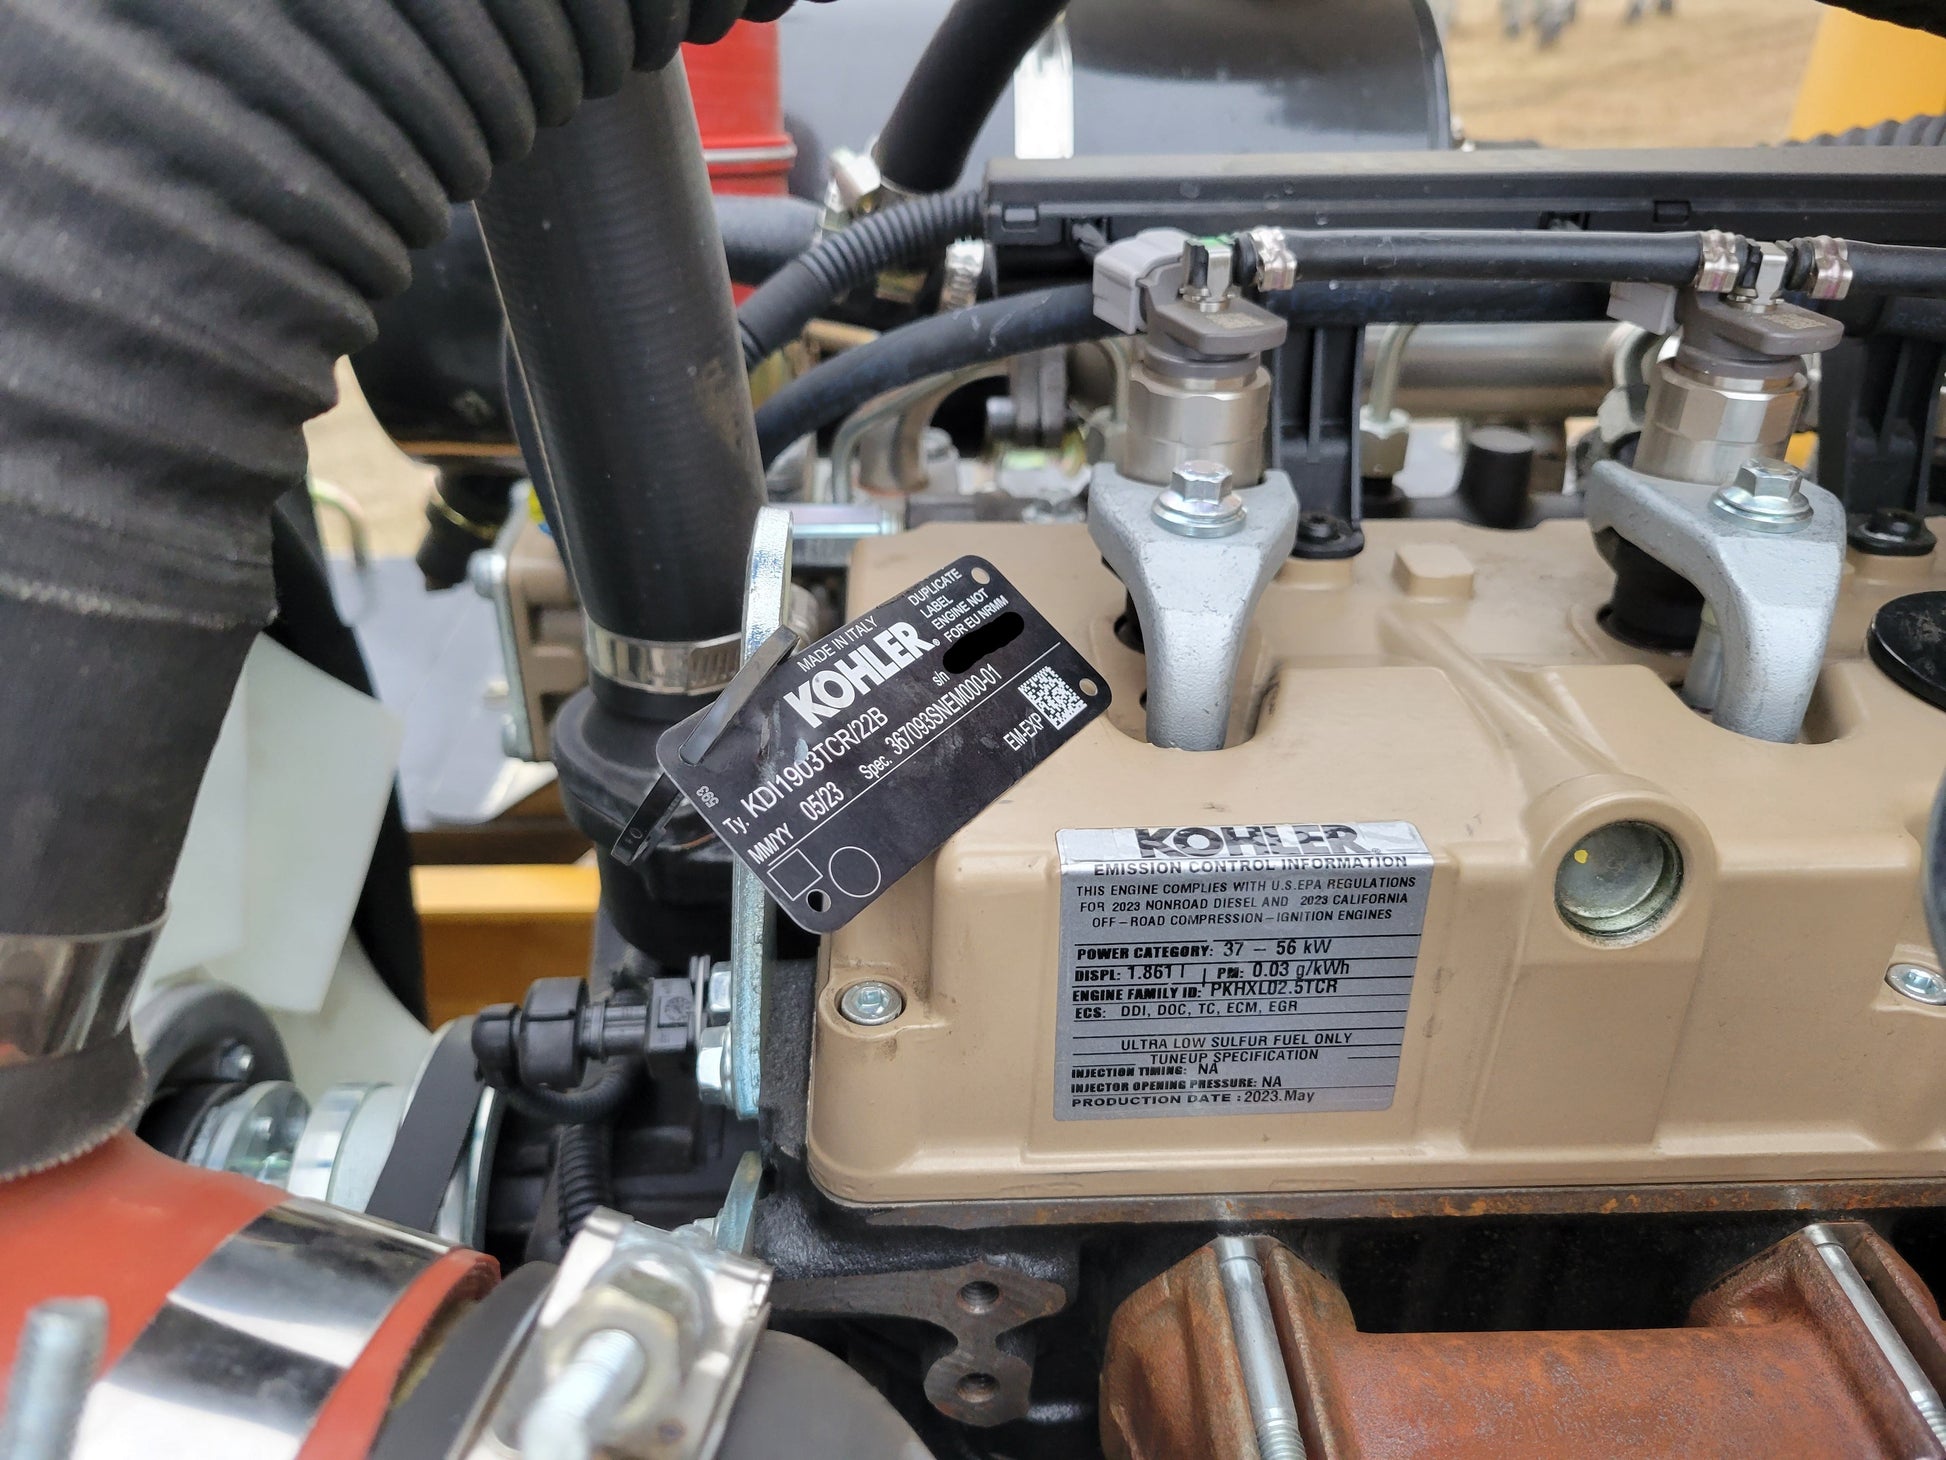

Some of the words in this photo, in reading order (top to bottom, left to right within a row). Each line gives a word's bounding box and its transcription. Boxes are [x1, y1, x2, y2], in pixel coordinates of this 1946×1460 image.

[908, 568, 962, 607] DUPLICATE
[920, 595, 954, 619] LABEL
[931, 604, 970, 631] ENGINE
[967, 588, 989, 611] NOT
[944, 625, 966, 642] FOR
[966, 614, 980, 629] EU
[976, 595, 1009, 621] NRMM
[797, 644, 835, 672] MADE
[834, 634, 849, 650] IN
[845, 616, 878, 642] ITALY
[783, 621, 934, 729] KOHLER
[932, 670, 950, 687] s/n
[1003, 712, 1045, 752] EM-EXP
[722, 816, 750, 834] Ty.
[740, 706, 889, 819] KDI1903TCR/22B
[747, 822, 794, 865] MM/YY
[799, 781, 845, 821] 05/23
[858, 755, 893, 780] Spec.
[884, 663, 1003, 755] 367093SNEM000-01
[696, 785, 720, 809] 593
[1134, 824, 1371, 858] KOHLER
[1094, 861, 1182, 876] EMISSION
[1189, 859, 1275, 873] CONTROL
[1282, 856, 1407, 871] INFORMATION
[1077, 886, 1105, 896] THIS
[1111, 884, 1158, 895] ENGINE
[1163, 882, 1227, 894] COMPLIES
[1233, 881, 1266, 892] WITH
[1271, 879, 1322, 891] U.S.EPA
[1327, 877, 1416, 889] REGULATIONS
[1080, 902, 1105, 912] FOR
[1112, 901, 1141, 912] 2023
[1146, 899, 1208, 910] NONROAD
[1213, 897, 1257, 909] DIESEL
[1262, 896, 1289, 907] AND
[1300, 895, 1328, 906] 2023
[1332, 893, 1408, 905] CALIFORNIA
[1338, 909, 1392, 920] ENGINES
[1077, 947, 1129, 960] POWER
[1134, 945, 1213, 959] CATEGORY:
[1223, 941, 1244, 956] 37
[1276, 940, 1296, 955] 56
[1304, 939, 1331, 954] kW
[1075, 969, 1121, 981] DISPL:
[1252, 961, 1289, 977] 0.03
[1296, 960, 1349, 979] g/kWh
[1072, 989, 1123, 1001] ENGINE
[1127, 987, 1178, 1000] FAMILY
[1182, 987, 1201, 998] ID:
[1075, 1007, 1106, 1018] ECS:
[1121, 1005, 1150, 1017] DDI,
[1157, 1003, 1191, 1016] DOC,
[1199, 1003, 1220, 1014] TC,
[1227, 1002, 1261, 1013] ECM,
[1269, 1000, 1298, 1012] EGR
[1121, 1038, 1167, 1050] ULTRA
[1173, 1037, 1206, 1048] LOW
[1211, 1036, 1267, 1047] SULFUR
[1273, 1034, 1309, 1045] FUEL
[1315, 1033, 1352, 1044] ONLY
[1150, 1052, 1207, 1064] TUNEUP
[1214, 1049, 1319, 1062] SPECIFICATION
[1071, 1067, 1135, 1078] INJECTION
[1138, 1066, 1187, 1076] TIMING:
[1198, 1063, 1218, 1074] NA
[1071, 1082, 1129, 1093] INJECTOR
[1132, 1080, 1186, 1091] OPENING
[1190, 1078, 1257, 1089] PRESSURE:
[1262, 1076, 1282, 1087] NA
[1072, 1095, 1181, 1107] PRODUCTION
